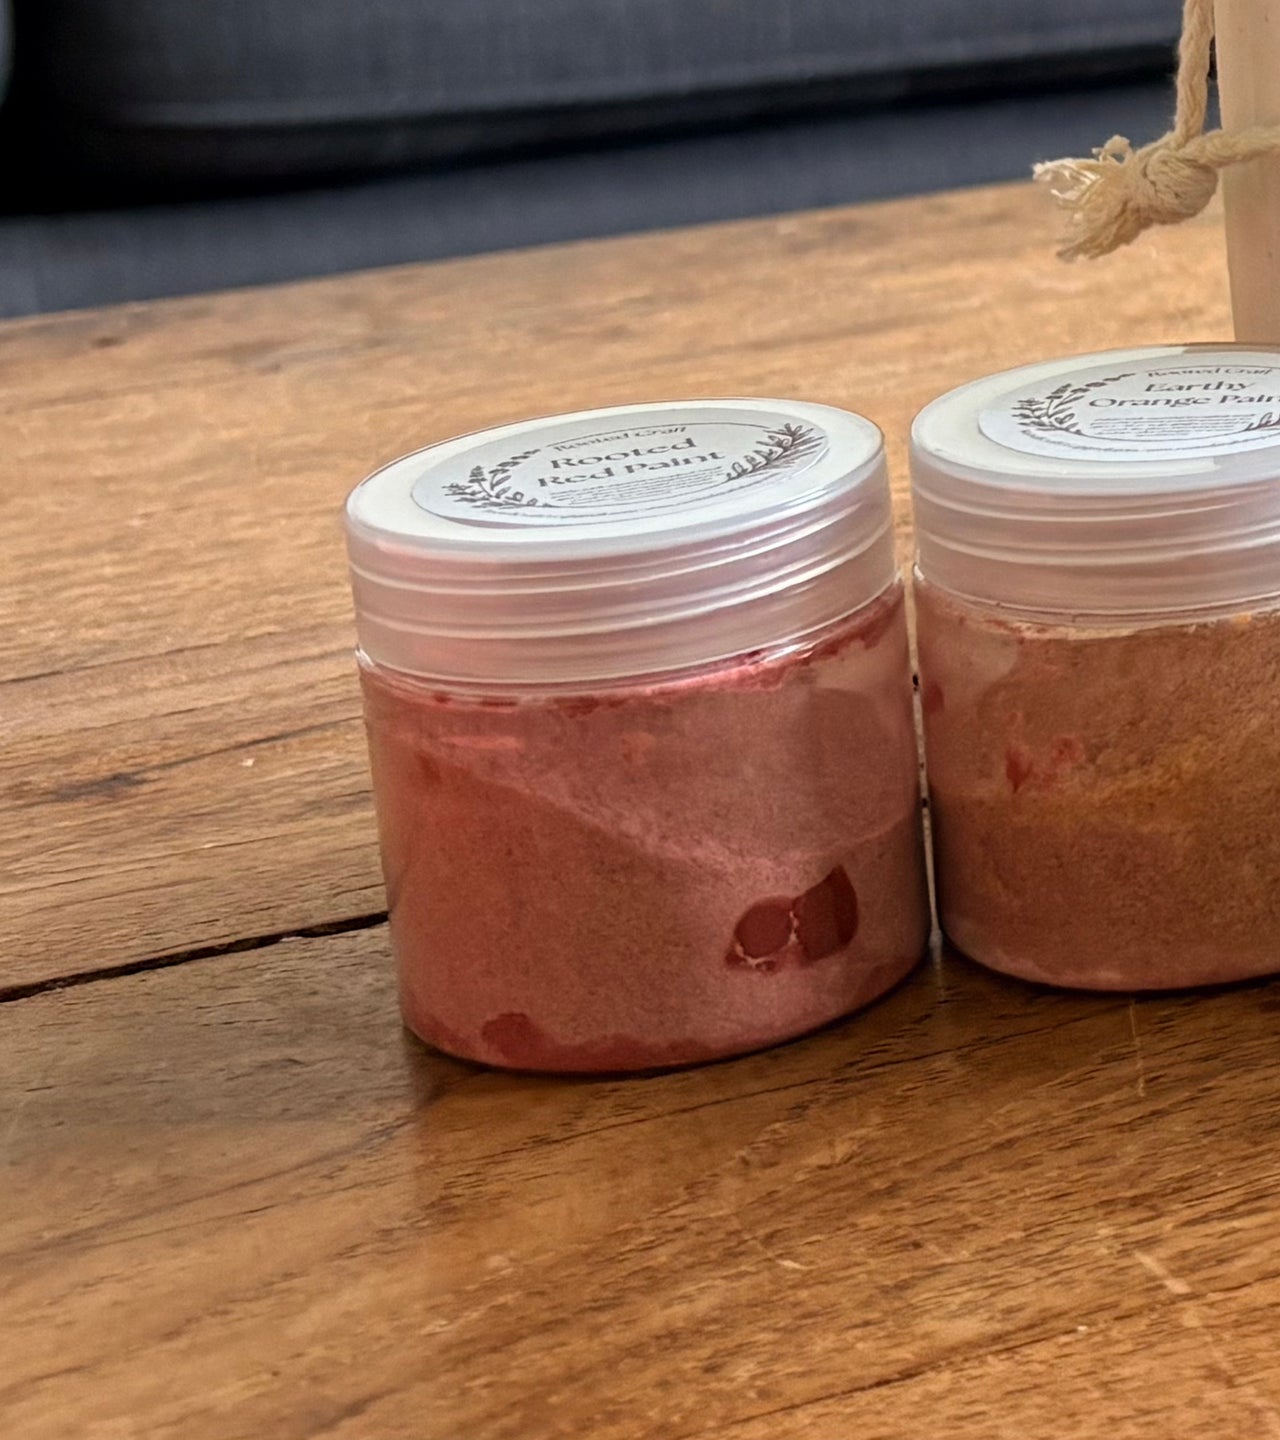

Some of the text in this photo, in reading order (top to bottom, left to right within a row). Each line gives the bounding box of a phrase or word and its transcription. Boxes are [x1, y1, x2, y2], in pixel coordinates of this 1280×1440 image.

[1145, 381, 1256, 392] Earthy
[1089, 396, 1211, 408] Orange
[551, 438, 697, 469] Rooted
[538, 467, 615, 487] Red
[625, 452, 726, 474] Paint
